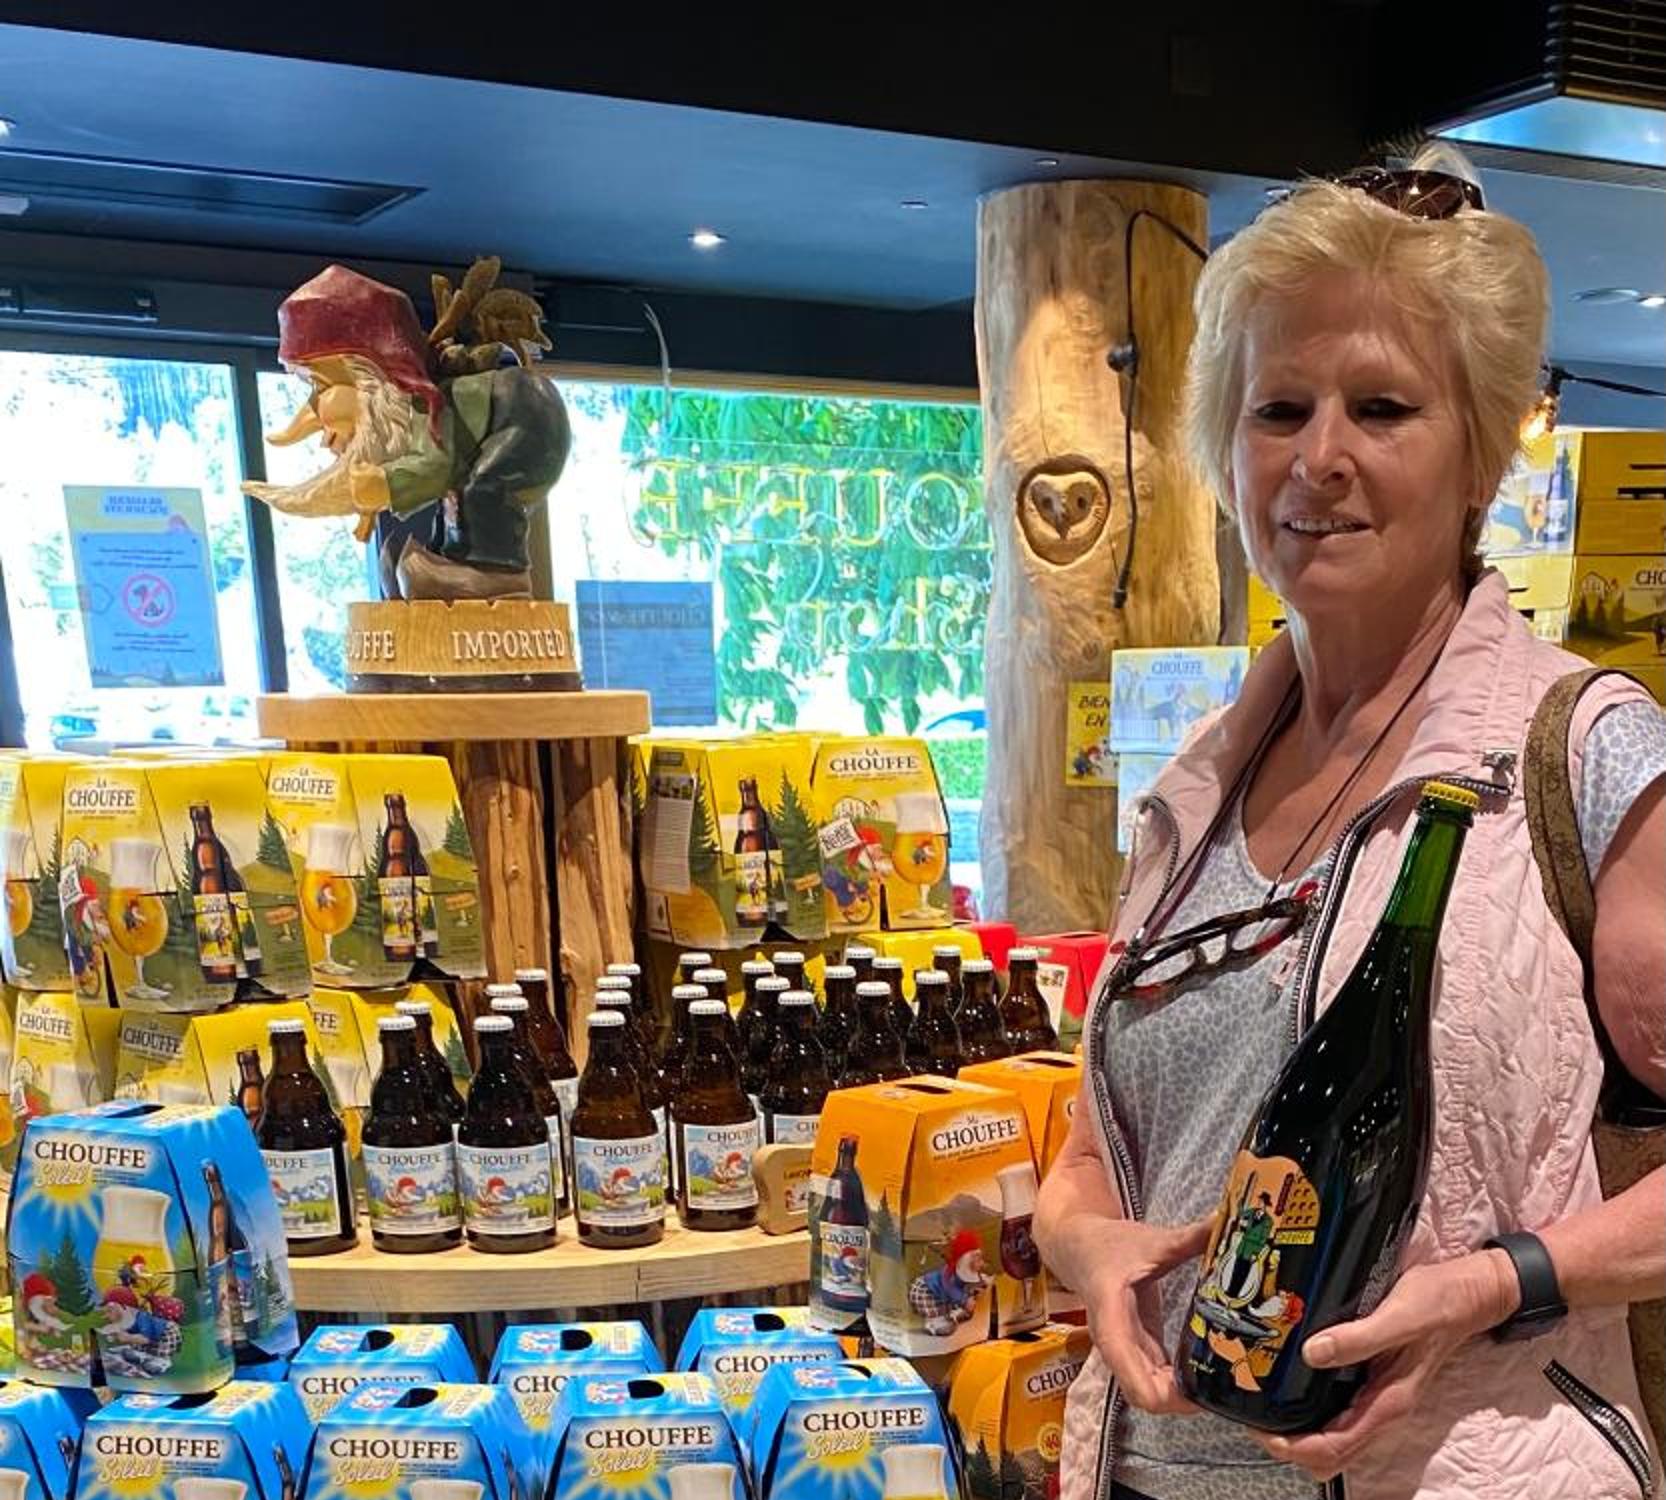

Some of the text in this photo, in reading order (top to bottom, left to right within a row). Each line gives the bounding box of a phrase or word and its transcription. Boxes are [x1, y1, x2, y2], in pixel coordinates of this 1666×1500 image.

[453, 630, 566, 660] IMPORTED
[830, 756, 918, 772] CHOUFFE
[68, 789, 135, 807] CHOUFFE
[271, 778, 336, 795] CHOUFFE
[19, 1012, 72, 1037] CHOUFFE
[123, 1028, 182, 1055] CHOUFFE
[932, 1117, 1018, 1151] CHOUFFE
[35, 1140, 147, 1169] CHOUFFE
[378, 1154, 441, 1165] CHOUFFE
[470, 1154, 531, 1165] CHOUFFE
[593, 1145, 653, 1157] CHOUFFE
[803, 1407, 925, 1432] CHOUFFE
[96, 1434, 221, 1459] CHOUFFE
[329, 1437, 459, 1461] CHOUFFE
[585, 1425, 713, 1449] CHOUFFE
[806, 1430, 867, 1459] Soleil
[99, 1456, 158, 1483] Soleil
[335, 1459, 400, 1486] Soleil
[589, 1446, 653, 1477] Soleil
